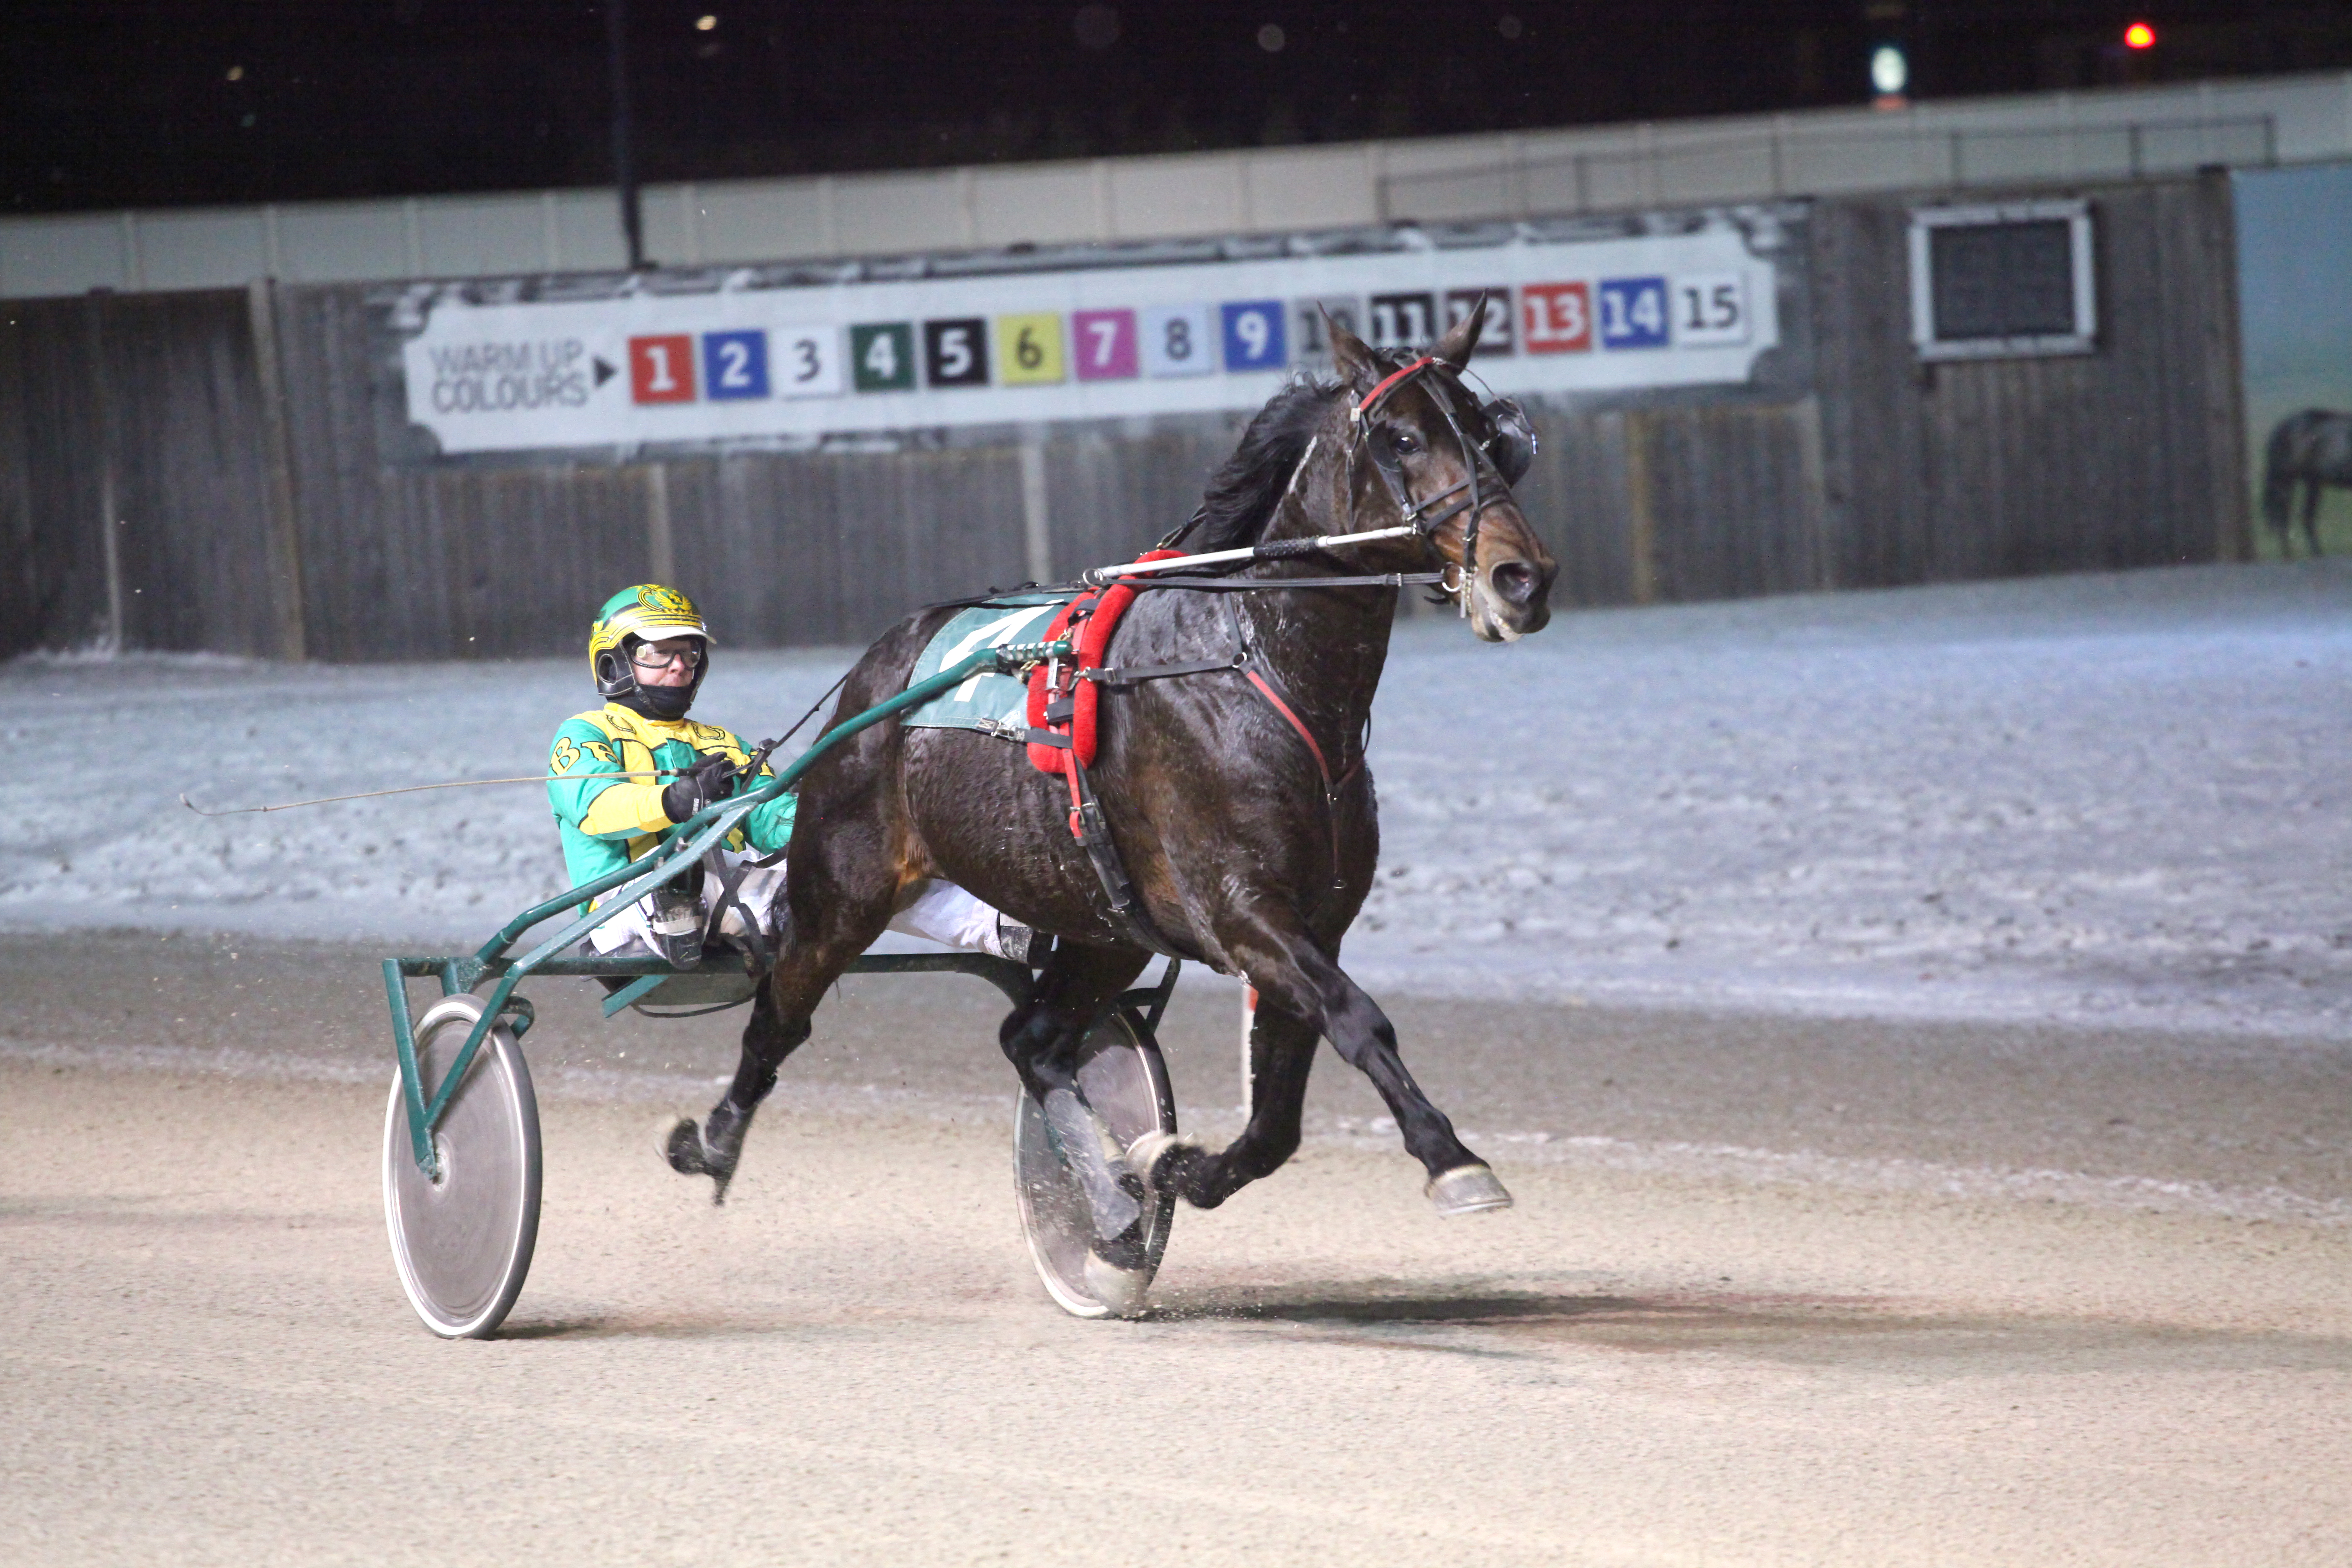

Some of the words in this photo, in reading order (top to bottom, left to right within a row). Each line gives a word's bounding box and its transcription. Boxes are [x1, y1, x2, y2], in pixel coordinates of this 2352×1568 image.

[428, 340, 532, 374] WARM
[539, 337, 585, 372] UP
[645, 345, 676, 392] 1
[719, 340, 752, 387] 2
[794, 338, 821, 383] 3
[864, 332, 899, 380] 4
[939, 328, 972, 377] 5
[1016, 327, 1043, 370] 6
[1088, 321, 1118, 367] 7
[1164, 317, 1192, 361] 8
[1233, 310, 1268, 360] 9
[1373, 302, 1427, 348] 11
[1447, 297, 1508, 343] 12
[1526, 293, 1586, 342] 13
[1605, 289, 1663, 336] 14
[1683, 285, 1738, 330] 15
[431, 372, 588, 414] COLOURS
